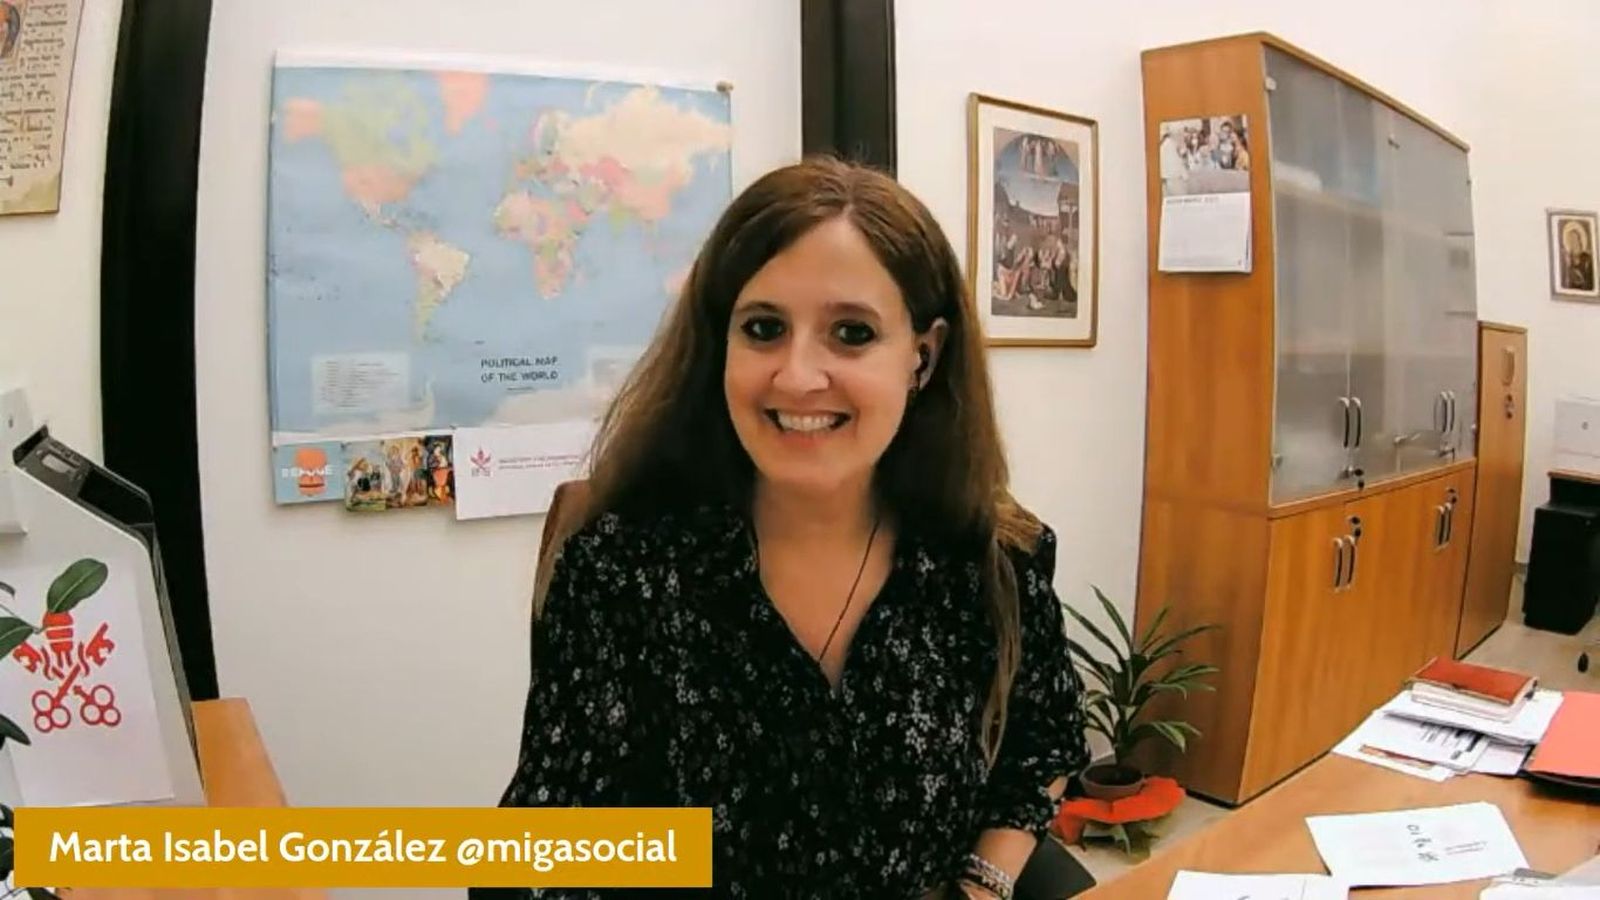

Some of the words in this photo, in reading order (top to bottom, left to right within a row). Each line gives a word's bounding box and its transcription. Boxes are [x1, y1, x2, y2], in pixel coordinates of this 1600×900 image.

[480, 357, 532, 368] POLITICAL
[535, 356, 558, 366] MAP
[480, 372, 495, 383] OF
[497, 372, 518, 382] THE
[521, 370, 559, 382] WORLD
